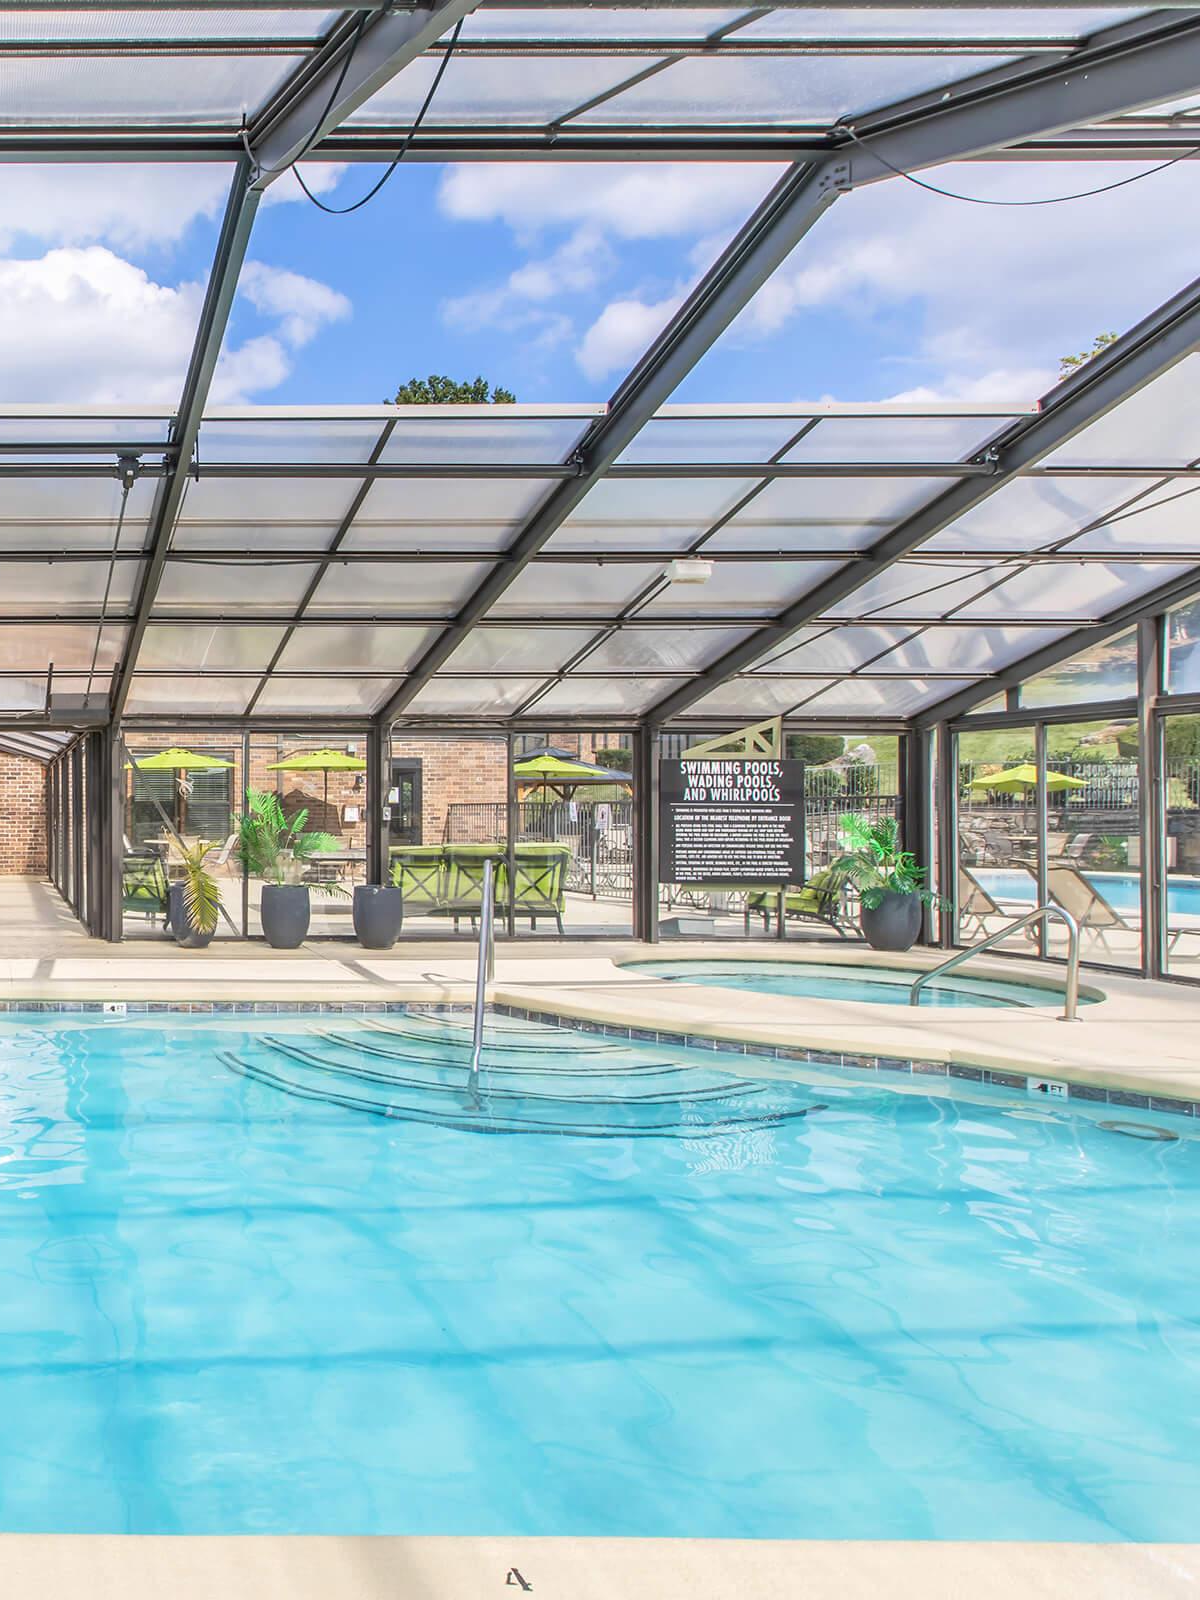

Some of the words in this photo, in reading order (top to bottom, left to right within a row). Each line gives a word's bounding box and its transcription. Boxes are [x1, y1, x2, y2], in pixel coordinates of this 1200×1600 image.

[680, 761, 741, 774] SWIMMING
[744, 761, 784, 778] POOLS,
[688, 775, 733, 788] WADING
[737, 775, 776, 790] POOLS,
[683, 788, 706, 801] AND
[711, 788, 780, 801] WHIRLPOOLS
[1050, 1084, 1063, 1092] FT
[504, 1567, 533, 1592] 4
